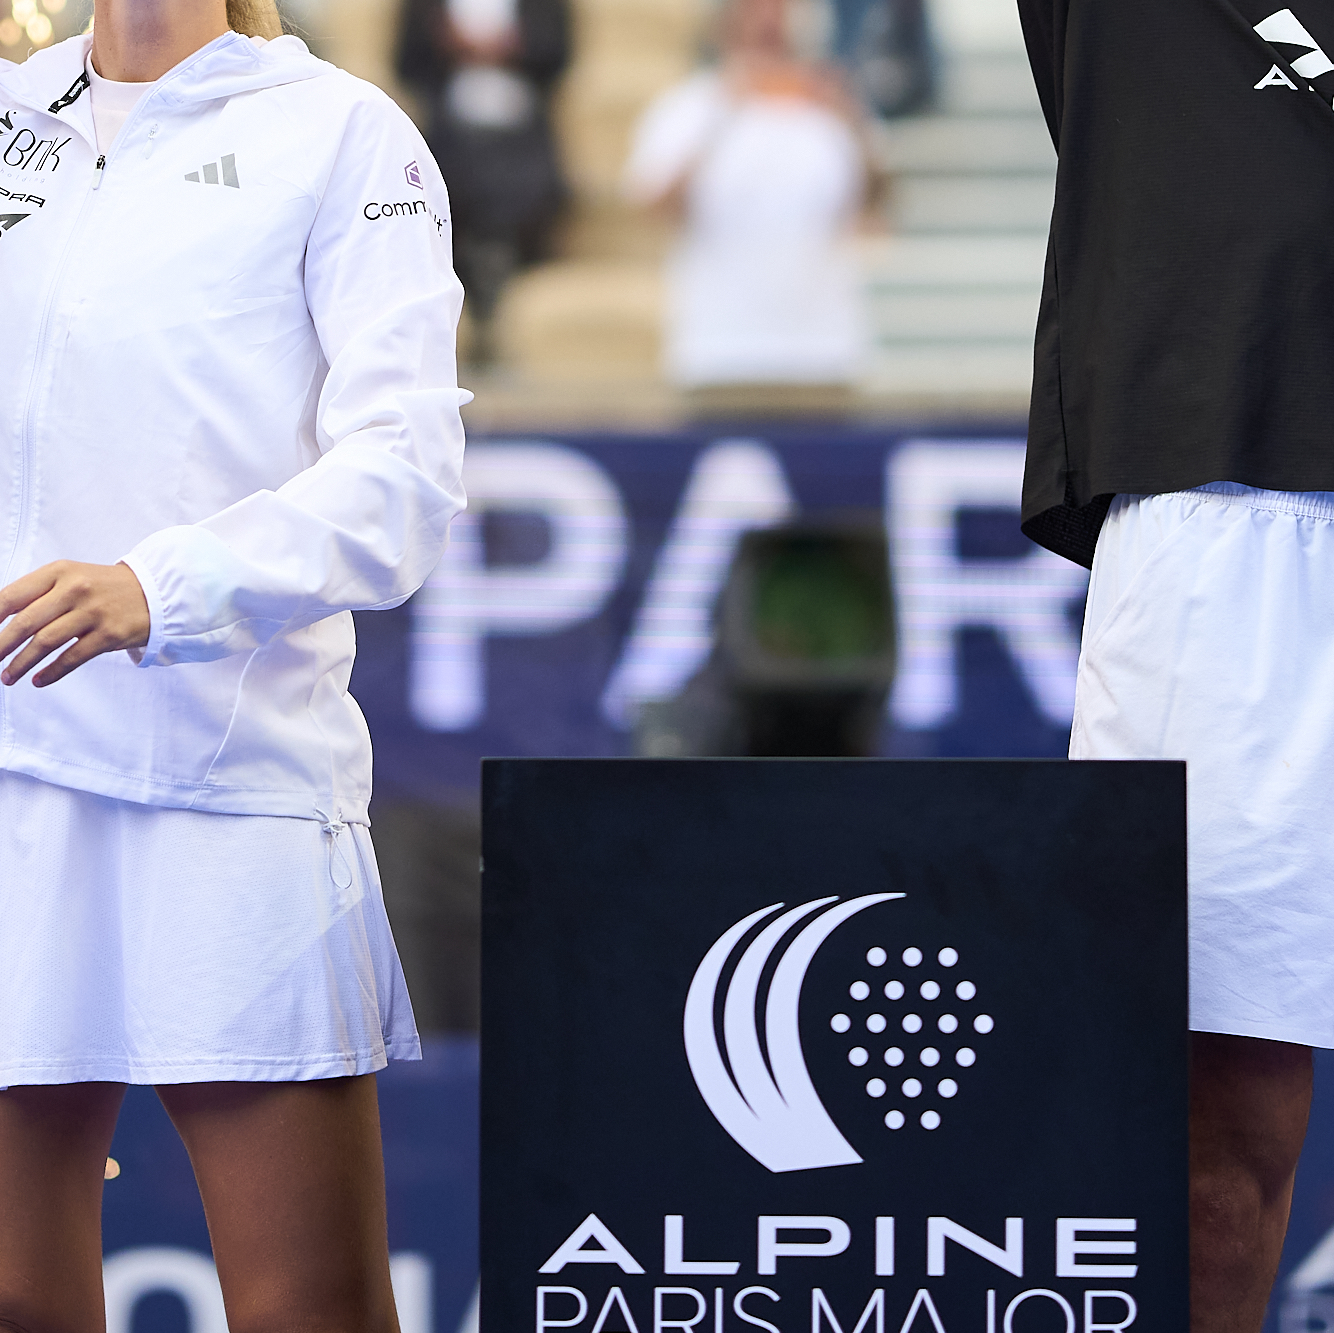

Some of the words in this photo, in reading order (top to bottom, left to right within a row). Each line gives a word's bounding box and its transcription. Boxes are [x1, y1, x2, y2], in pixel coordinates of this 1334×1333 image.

[537, 1212, 1139, 1278] ALPINE
[535, 1285, 782, 1333] PARIS
[810, 1287, 1139, 1333] MAJOR
